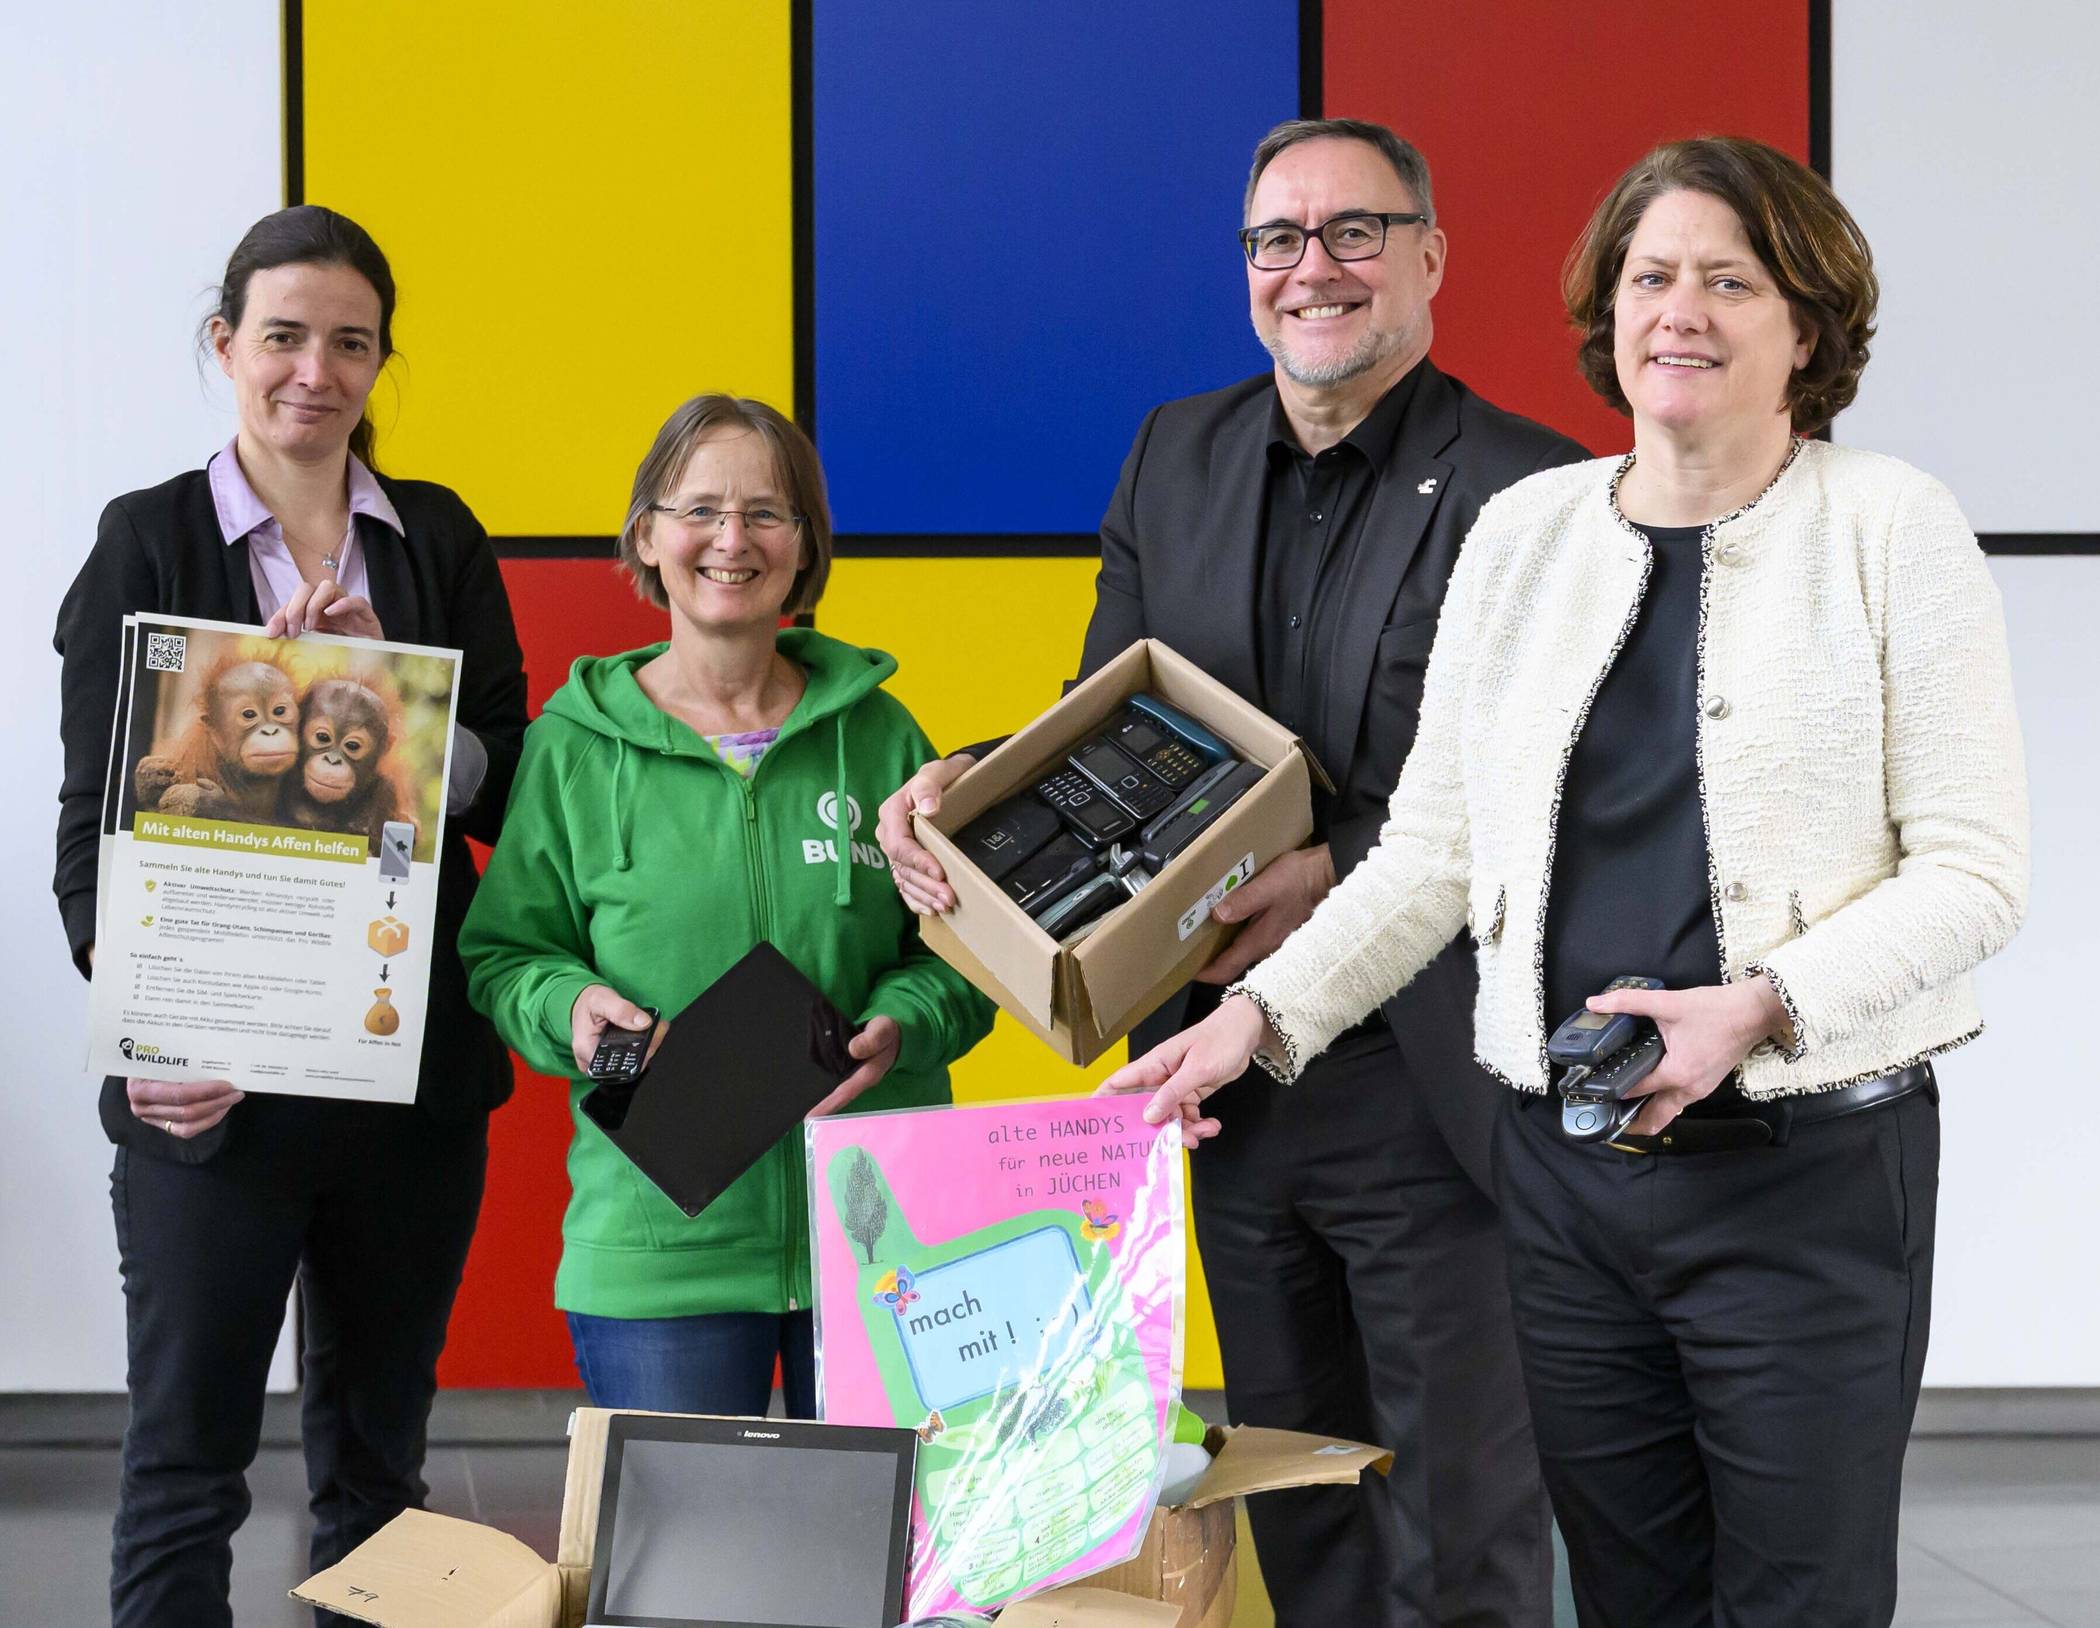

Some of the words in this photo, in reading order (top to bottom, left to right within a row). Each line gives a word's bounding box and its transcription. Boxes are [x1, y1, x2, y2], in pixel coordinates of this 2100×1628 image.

[142, 821, 170, 836] Mit
[172, 825, 210, 840] alten
[213, 829, 269, 849] Handys
[271, 835, 311, 852] Affen
[314, 840, 360, 857] helfen
[139, 860, 179, 871] Sammeln
[194, 866, 210, 874] alte
[212, 868, 244, 878] Handys
[245, 872, 262, 880] und
[263, 874, 278, 882] tun
[279, 875, 292, 883] Sie
[293, 877, 318, 886] damit
[319, 880, 346, 889] Gutes!
[135, 1053, 189, 1067] WILDLIFE
[136, 1044, 160, 1055] PRO
[988, 1125, 1038, 1144] alte
[1050, 1115, 1126, 1139] HANDYS
[999, 1156, 1026, 1171] für
[1039, 1151, 1089, 1168] neue
[1016, 1183, 1034, 1198] in
[1047, 1171, 1121, 1196] JÜCHEN
[908, 1289, 983, 1336] mach
[743, 1430, 780, 1439] lenovo
